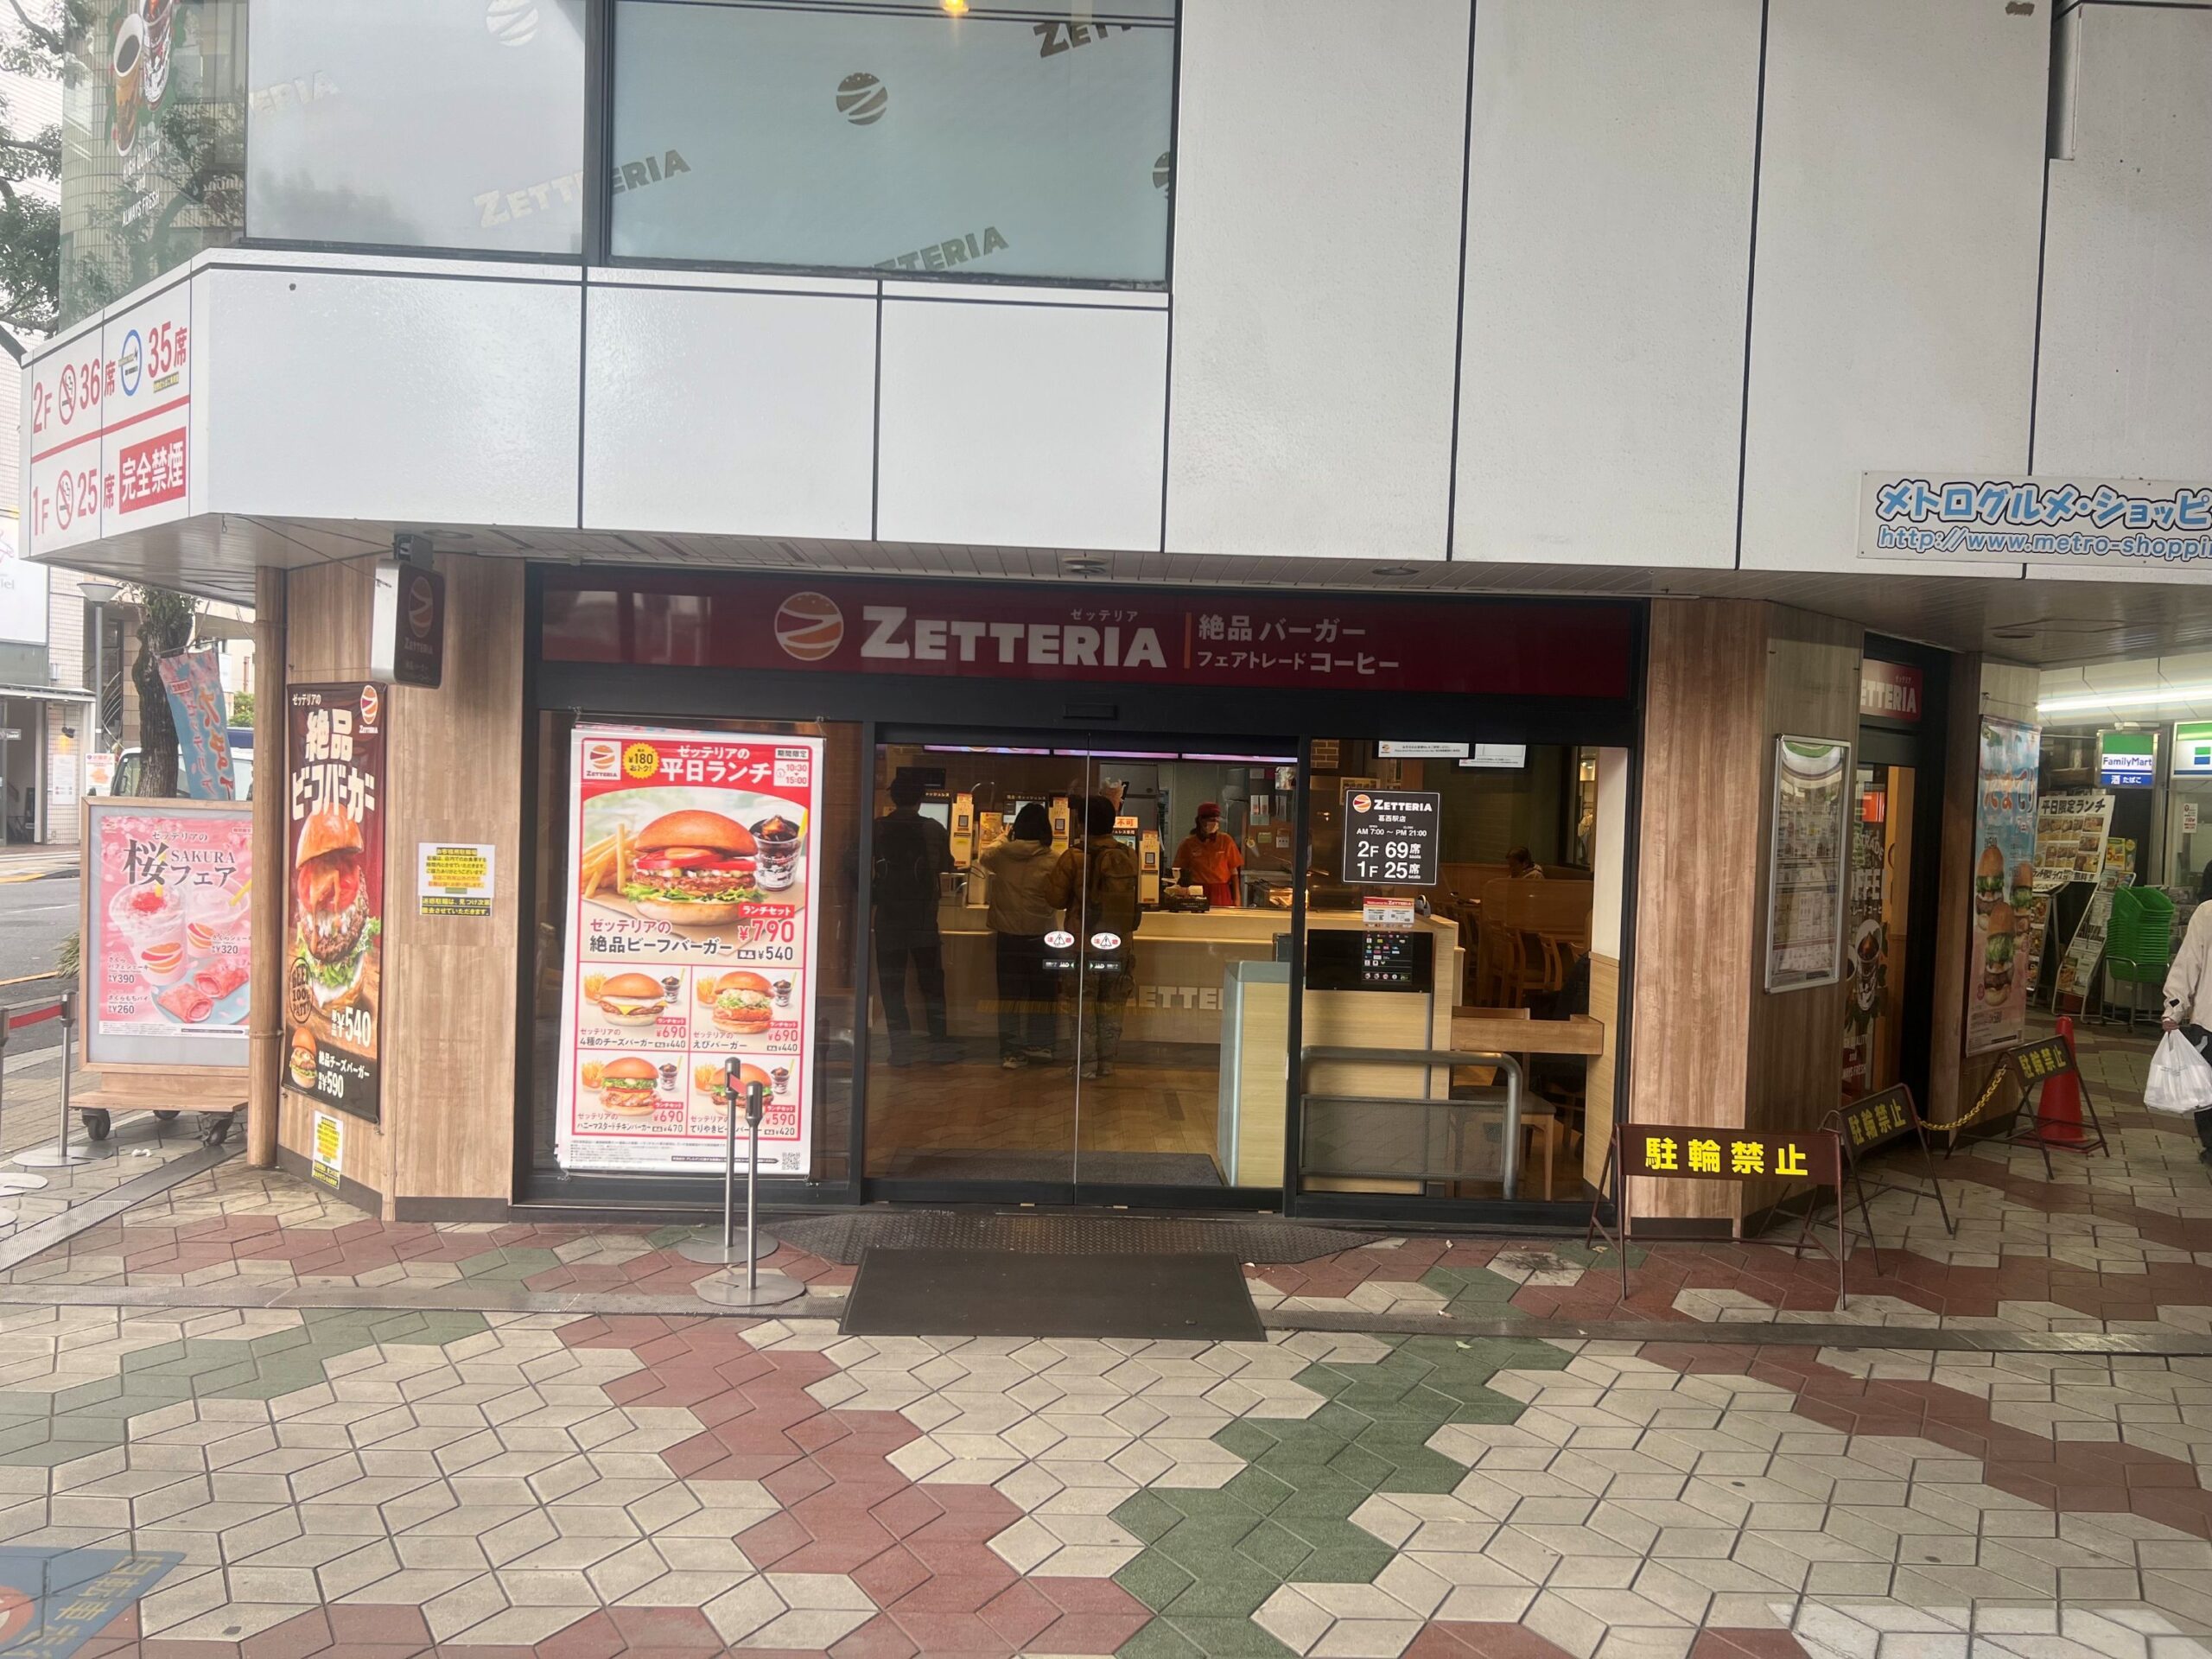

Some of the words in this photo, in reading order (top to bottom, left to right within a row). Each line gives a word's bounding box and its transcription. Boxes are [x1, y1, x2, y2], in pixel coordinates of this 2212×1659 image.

[1033, 22, 1132, 58] ZET
[33, 381, 53, 435] 2F
[148, 321, 188, 378] 35席
[33, 486, 50, 536] 1F
[121, 441, 185, 502] 完全禁煙
[1070, 608, 1139, 623] ゼッテリア
[859, 605, 1166, 669] ZETTERIA
[1197, 649, 1400, 677] フェアトレードコーヒー
[292, 694, 321, 706] ゼッテリアの
[305, 709, 353, 762] 絶品
[628, 753, 653, 765] ¥180
[677, 746, 750, 760] ゼッテリアの
[777, 749, 808, 759] 期間限定
[785, 764, 807, 773] 10:30
[2102, 757, 2152, 766] FamilyMart
[660, 759, 772, 784] 平日ランチ
[785, 776, 807, 785] 15:00
[2111, 775, 2120, 785] 酒
[292, 763, 375, 823] ビーフバーガー
[1374, 799, 1433, 811] ZETTERIA
[2041, 798, 2105, 814] 平日限定ランチ
[1357, 841, 1379, 857] 2F
[171, 850, 235, 864] SAKURA
[1357, 861, 1378, 878] 1F
[741, 905, 792, 917] ランチセット
[589, 919, 671, 934] ゼッテリアの
[738, 920, 794, 943] ¥790
[589, 936, 732, 955] 絶品ビーフバーガー
[758, 946, 793, 961] ¥540
[337, 1006, 372, 1047] ¥540
[657, 1026, 686, 1039] ¥690
[580, 1038, 654, 1047] 4種のチーズバーガー
[767, 1030, 798, 1041] ¥690
[693, 1040, 747, 1049] えびバーガー
[319, 1051, 370, 1080] 絶品チーズバーガー
[2018, 1045, 2067, 1079] 駐輪禁止
[322, 1071, 344, 1099] ¥590
[577, 1112, 619, 1121] ゼッテリアの
[653, 1111, 683, 1122] ¥690
[766, 1113, 795, 1126] ¥590
[1848, 1098, 1906, 1146] 駐輪禁止
[1645, 1136, 1808, 1177] 駐輪禁止
